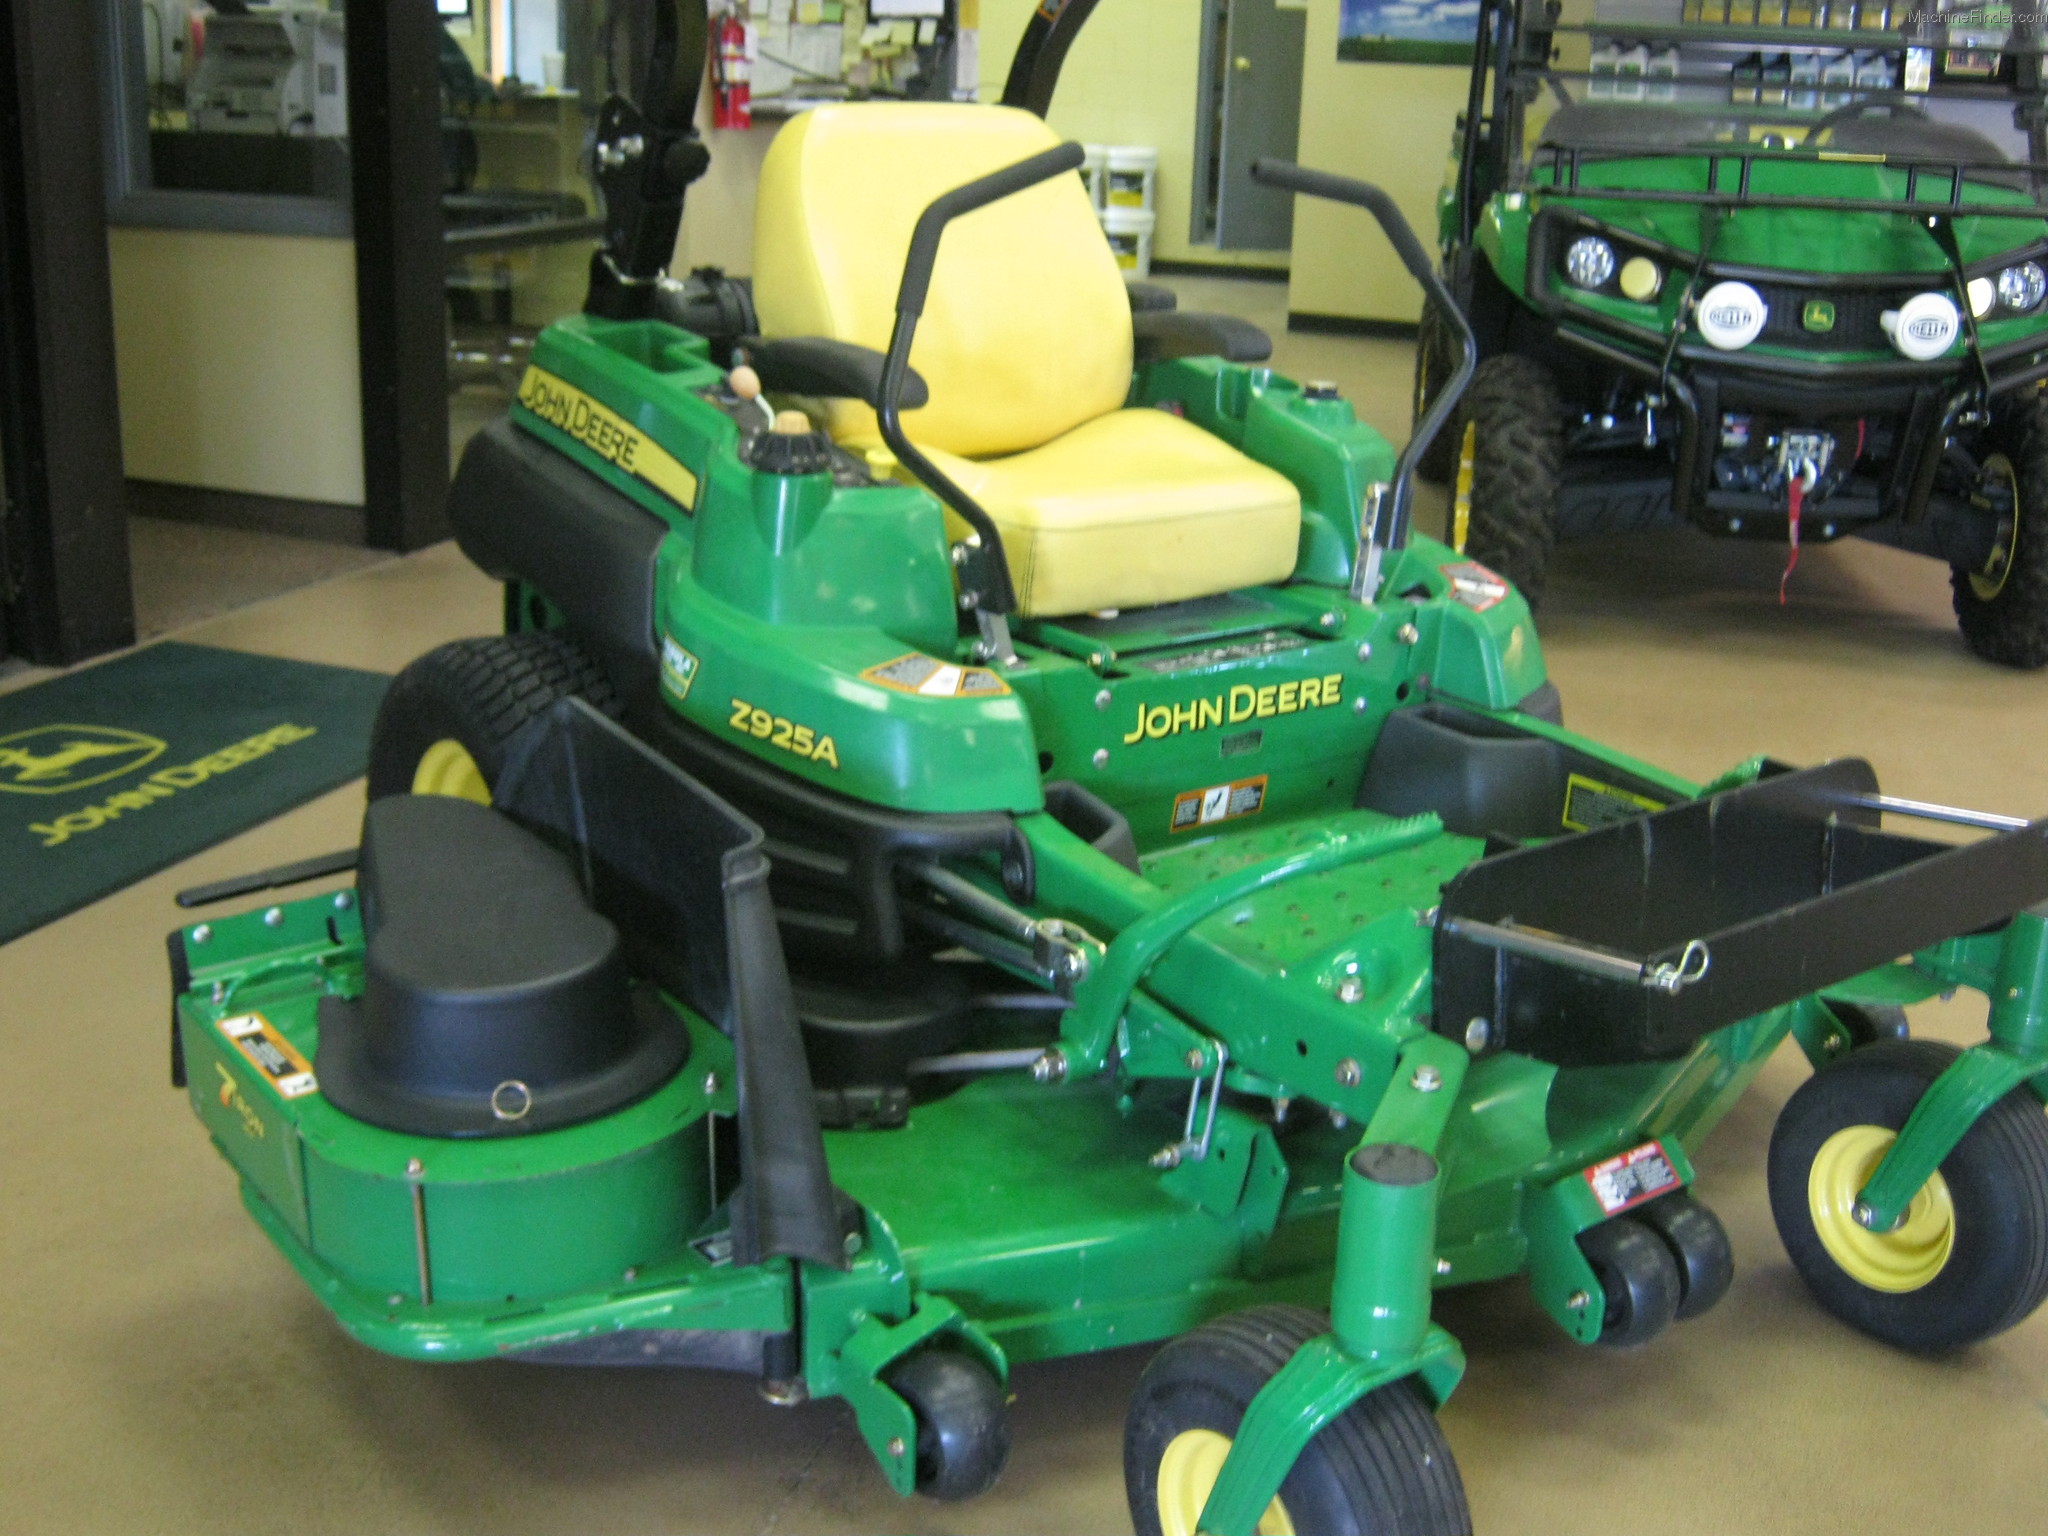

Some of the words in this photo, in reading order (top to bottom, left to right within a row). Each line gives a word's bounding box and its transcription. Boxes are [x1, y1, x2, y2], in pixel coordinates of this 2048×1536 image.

[524, 373, 573, 427] JOHN
[571, 397, 639, 467] DEERE
[729, 698, 841, 770] Z925A
[1123, 694, 1224, 744] JOHN
[1228, 673, 1343, 724] DEERE
[28, 783, 176, 848] JOHN
